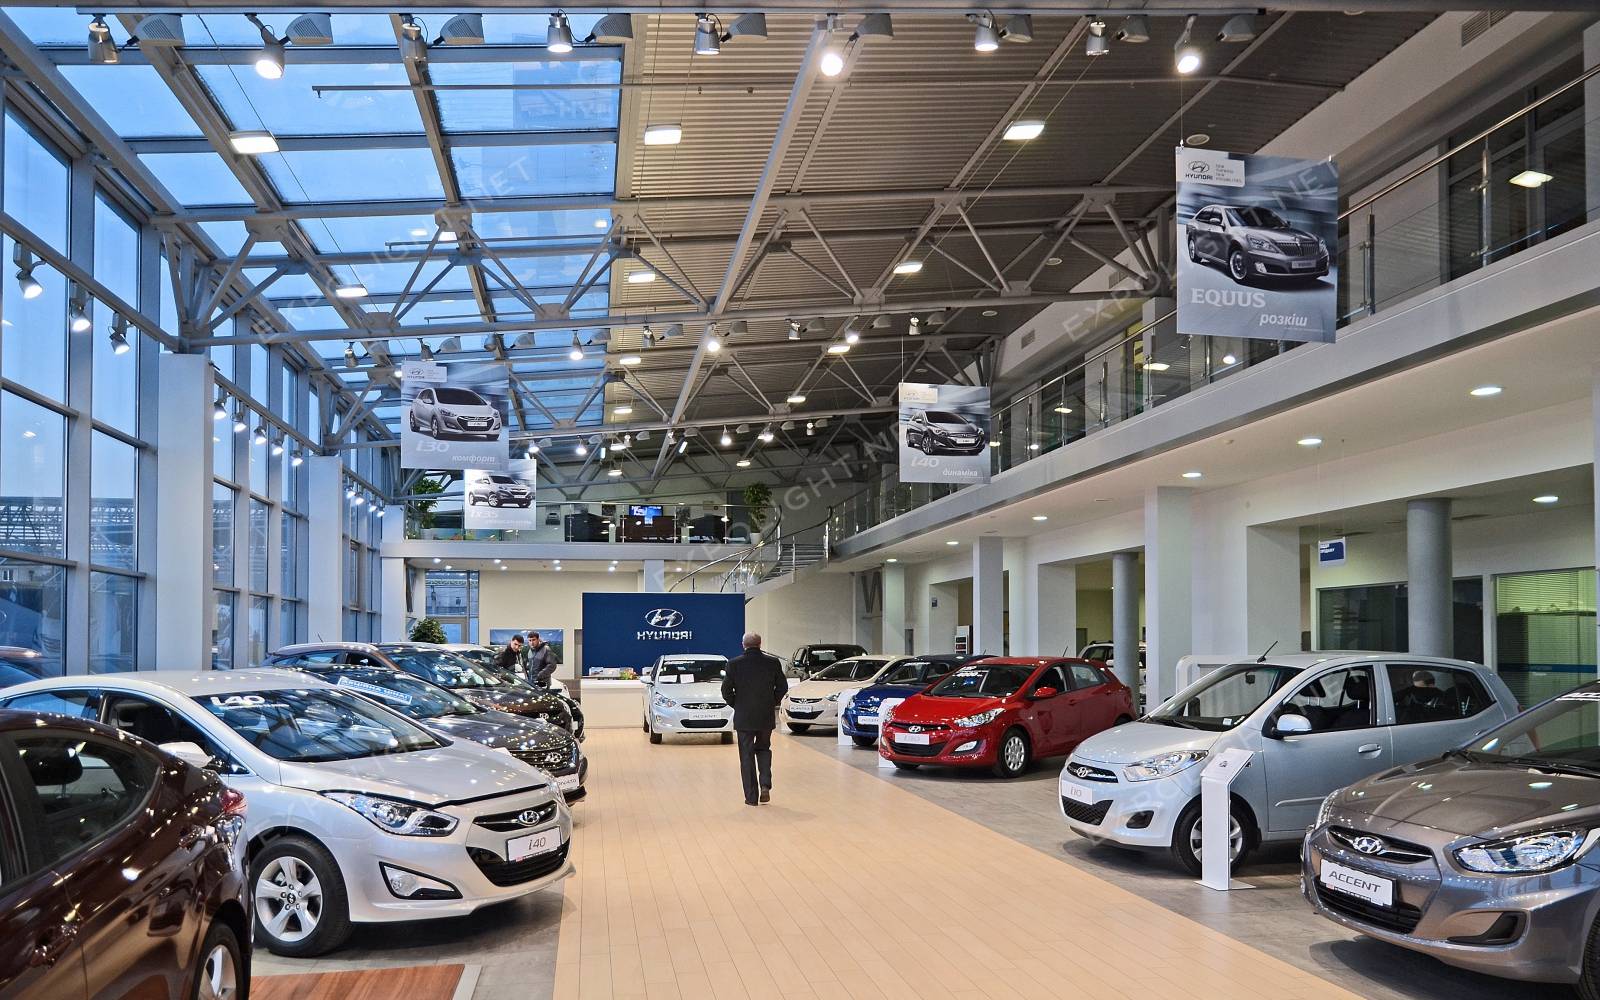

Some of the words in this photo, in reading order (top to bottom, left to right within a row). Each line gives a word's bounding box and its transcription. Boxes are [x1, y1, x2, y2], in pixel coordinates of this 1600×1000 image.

[1185, 173, 1213, 181] HYUNDAI
[1191, 287, 1266, 308] EQUUS
[1259, 313, 1308, 327] розкіш
[637, 630, 693, 640] HYUNDAI
[528, 837, 546, 850] i40
[1328, 870, 1381, 892] ACCENT
